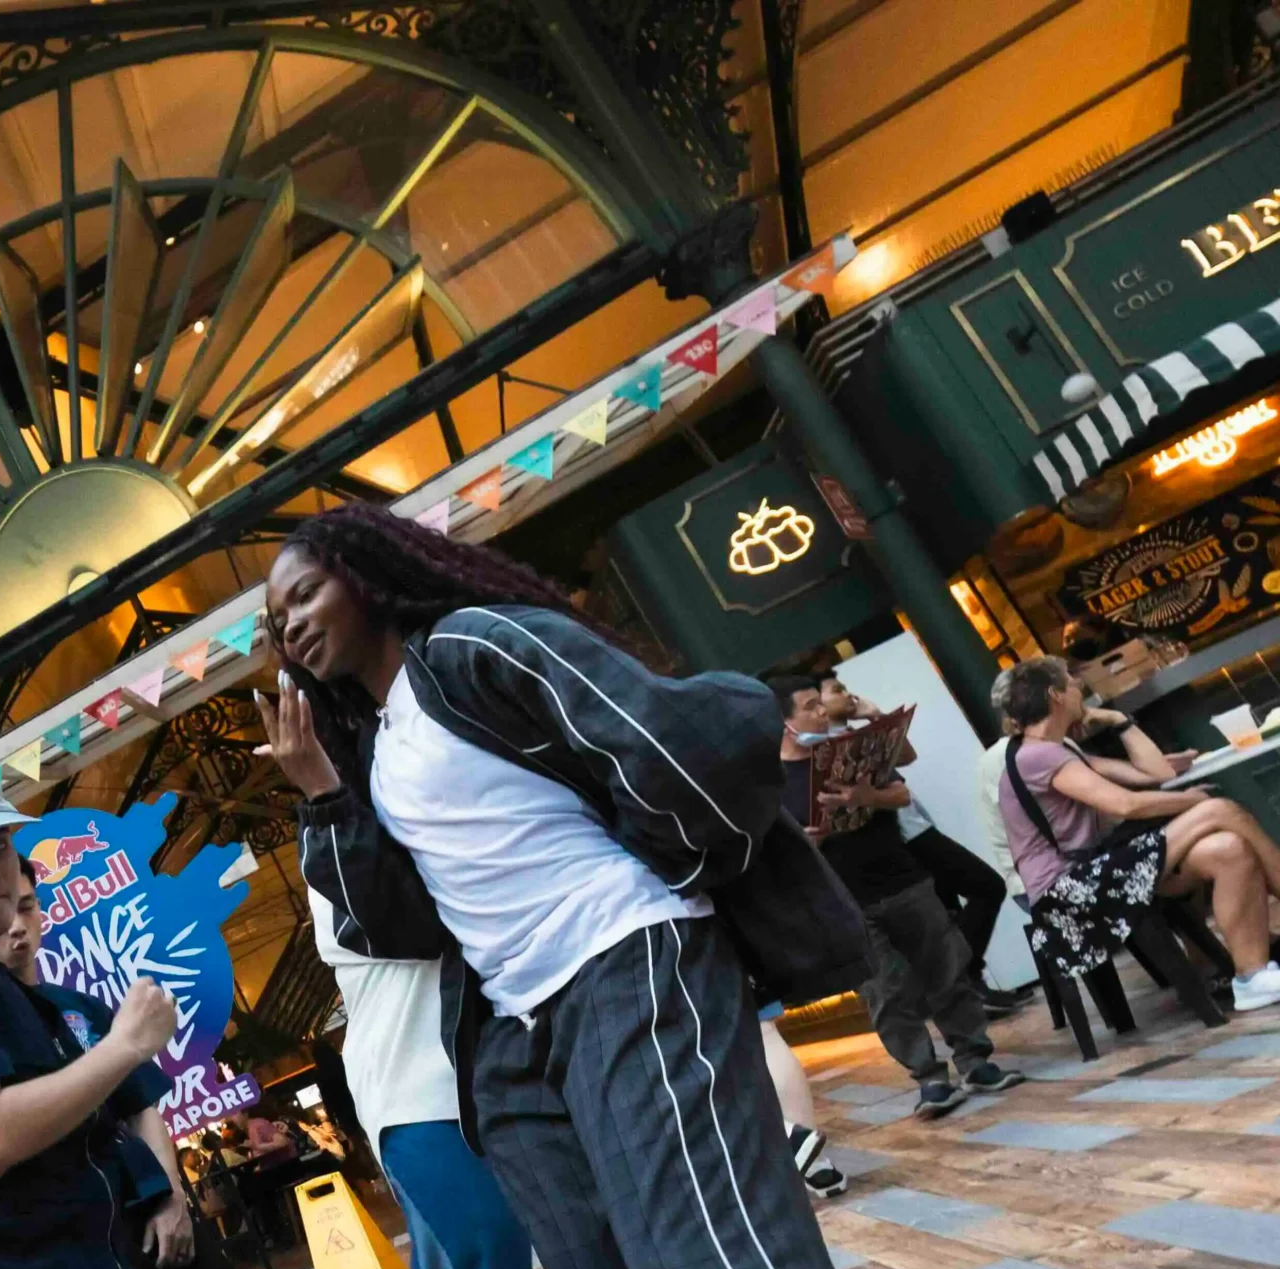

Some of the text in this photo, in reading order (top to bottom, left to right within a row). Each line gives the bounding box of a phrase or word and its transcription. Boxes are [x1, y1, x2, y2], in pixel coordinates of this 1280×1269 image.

[1181, 188, 1280, 278] BE
[1111, 265, 1146, 293] ICE
[1113, 278, 1174, 318] COLD
[1164, 538, 1226, 580] STOUT
[40, 849, 139, 936] ed Bull
[36, 893, 154, 985] DANCE
